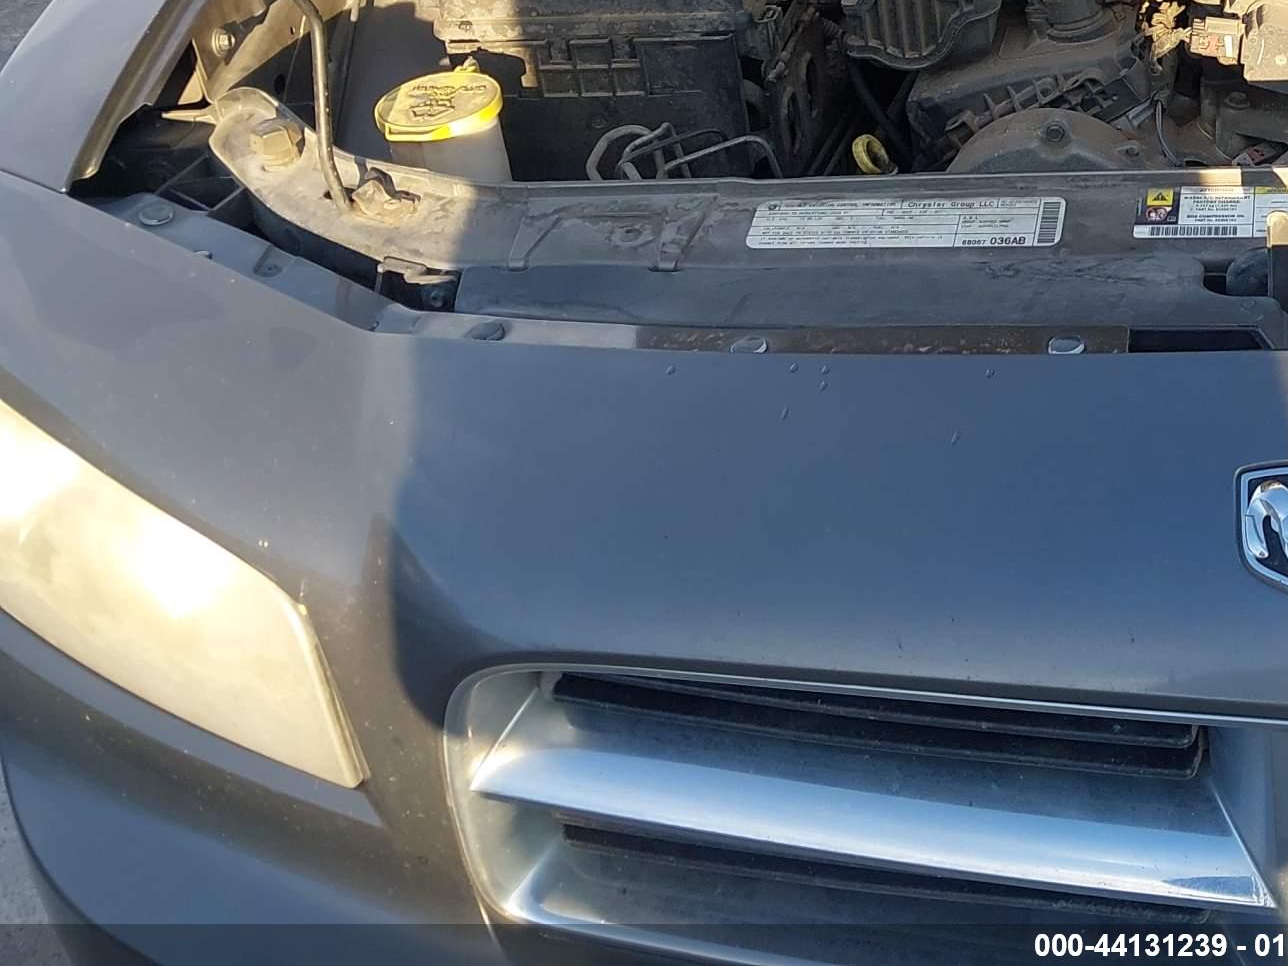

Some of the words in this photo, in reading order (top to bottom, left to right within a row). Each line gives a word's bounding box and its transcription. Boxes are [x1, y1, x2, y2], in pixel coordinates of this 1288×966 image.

[907, 200, 946, 210] Chrysler
[950, 201, 975, 209] Group
[989, 235, 1026, 246] 036AB
